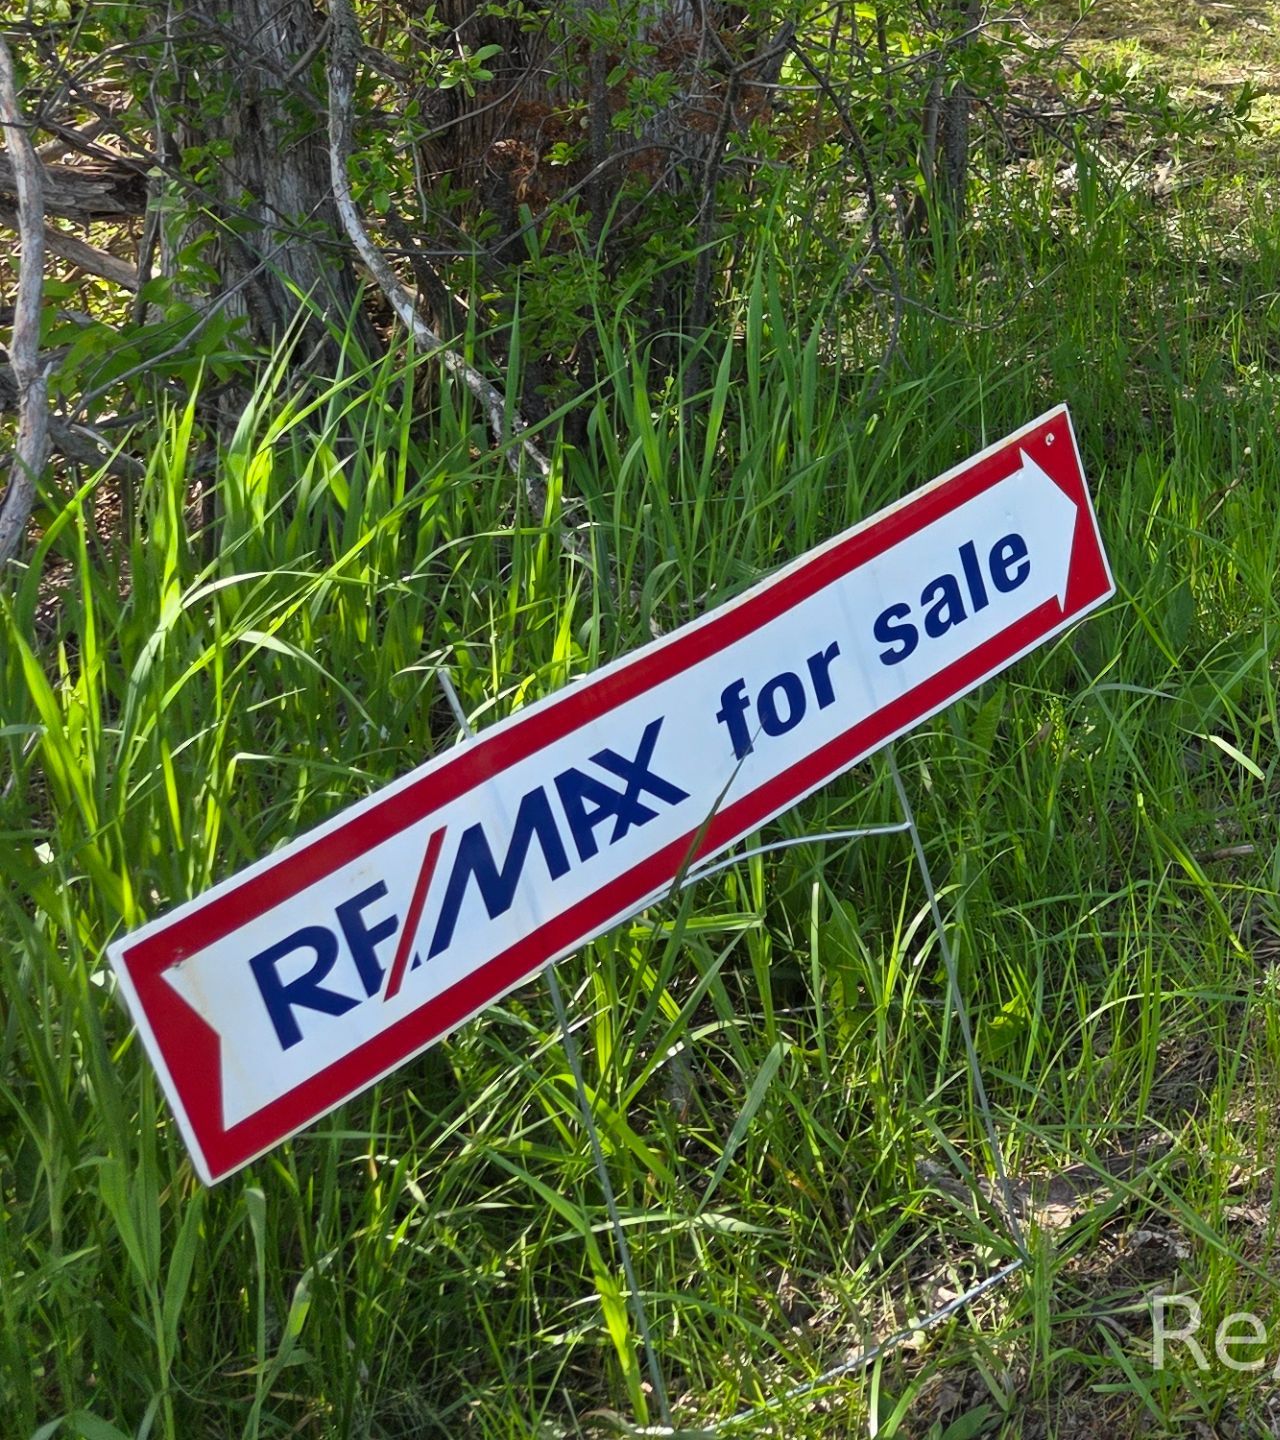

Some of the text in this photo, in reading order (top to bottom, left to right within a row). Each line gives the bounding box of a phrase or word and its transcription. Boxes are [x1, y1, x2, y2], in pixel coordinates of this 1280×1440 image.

[249, 532, 1032, 1051] RE/MAX for sale
